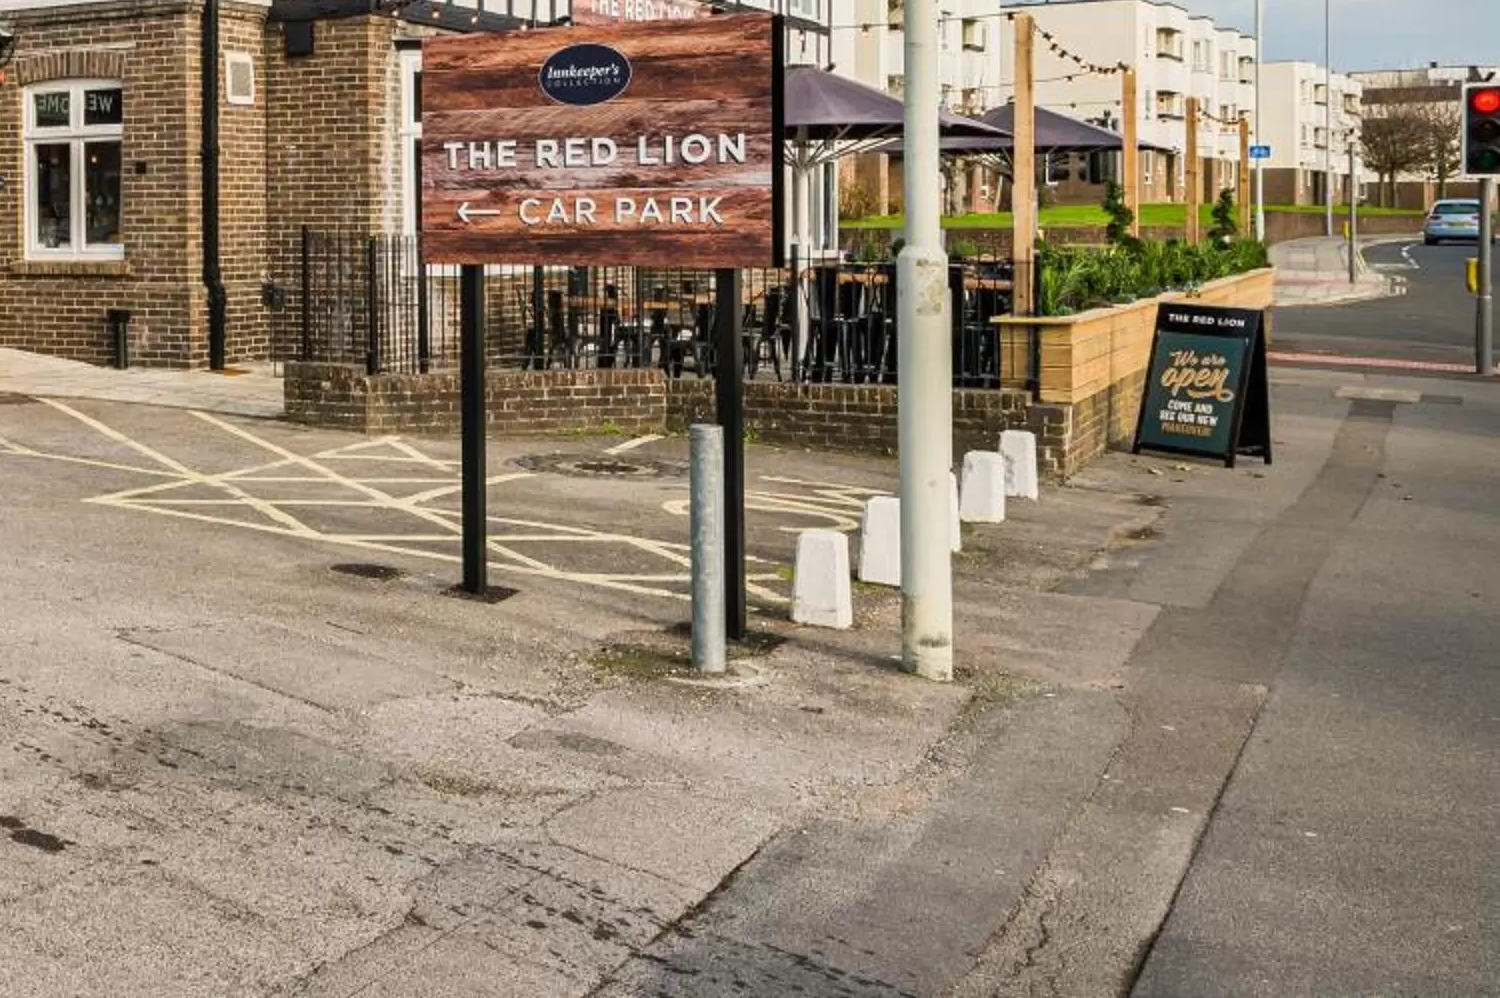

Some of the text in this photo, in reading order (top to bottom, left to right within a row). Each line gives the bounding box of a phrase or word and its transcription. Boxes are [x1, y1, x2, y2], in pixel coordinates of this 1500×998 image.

[547, 63, 620, 80] Innkeeper's
[444, 133, 746, 169] THE RED LION
[518, 196, 725, 225] CAR PARK
[1168, 313, 1245, 328] THE RED LION
[1160, 367, 1235, 403] open
[1167, 399, 1213, 414] COME AND
